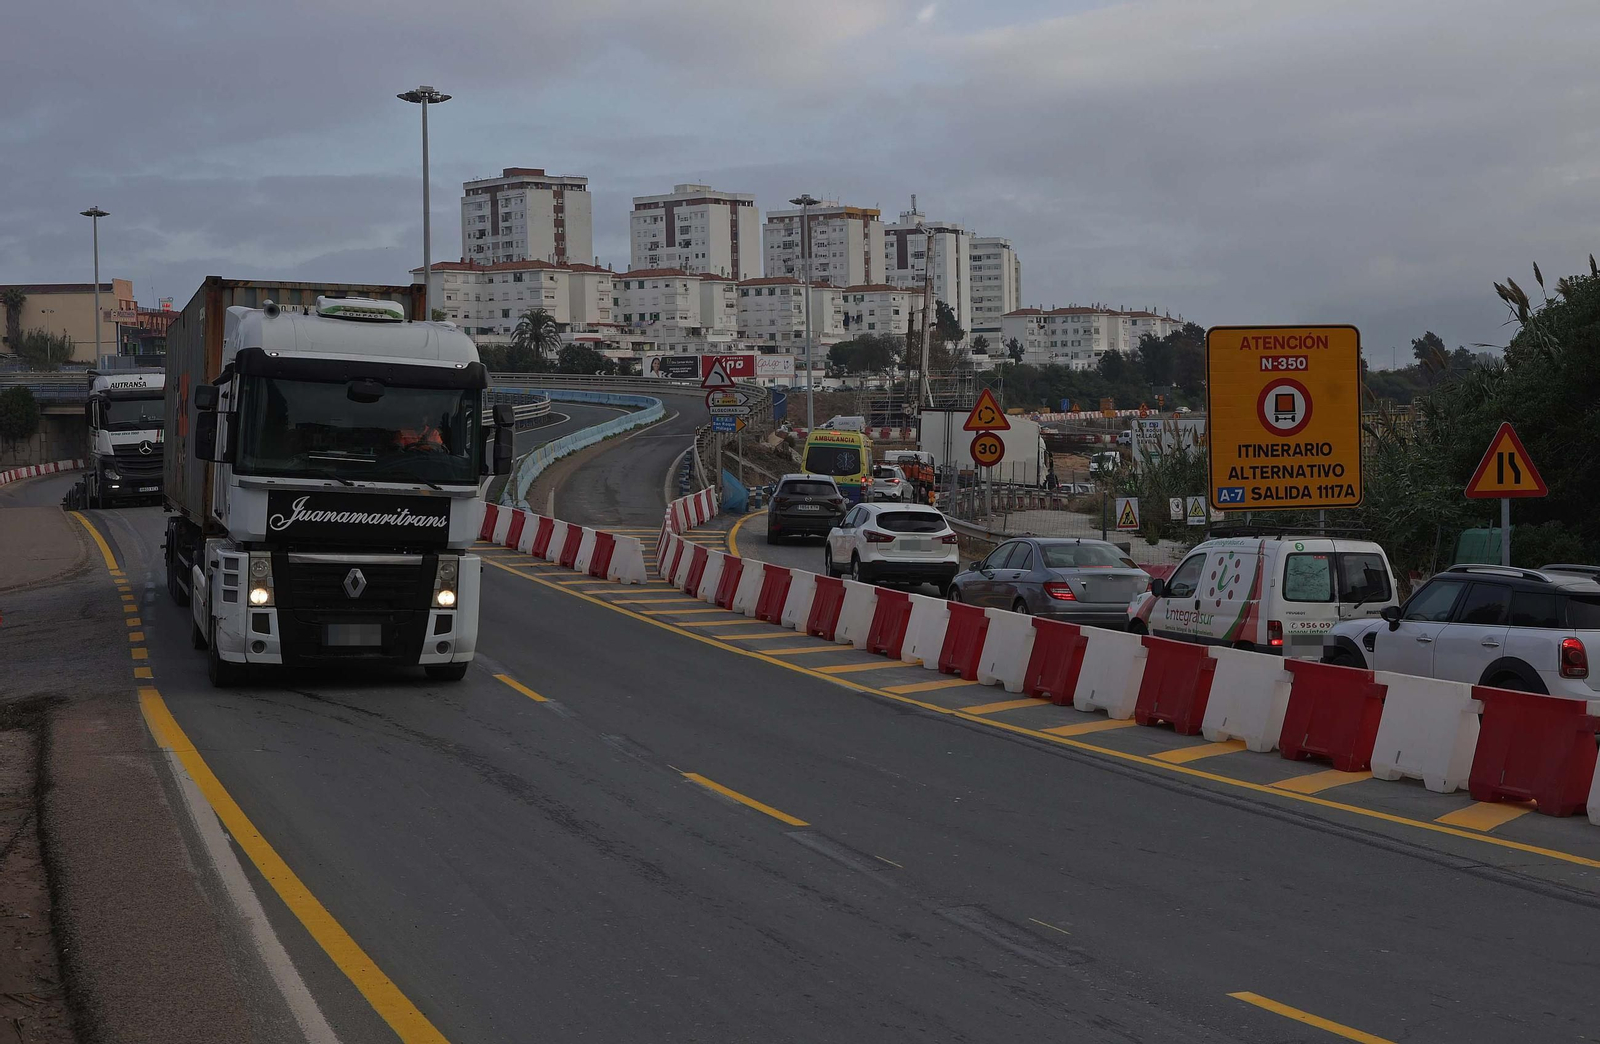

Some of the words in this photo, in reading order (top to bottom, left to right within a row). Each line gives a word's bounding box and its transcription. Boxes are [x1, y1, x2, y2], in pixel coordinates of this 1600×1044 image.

[1239, 332, 1329, 351] ATENCIÓN
[1261, 356, 1307, 370] N-350
[110, 382, 147, 390] AUTRANSA
[979, 443, 997, 454] 30
[1237, 442, 1333, 459] ITINERARIO
[1228, 463, 1344, 481] ALTERNATIVO
[1219, 489, 1243, 502] A-7
[1251, 486, 1312, 502] SALIDA
[1317, 484, 1356, 500] 1117A
[269, 495, 448, 531] Juanamaritrans
[1166, 600, 1214, 626] integralsur
